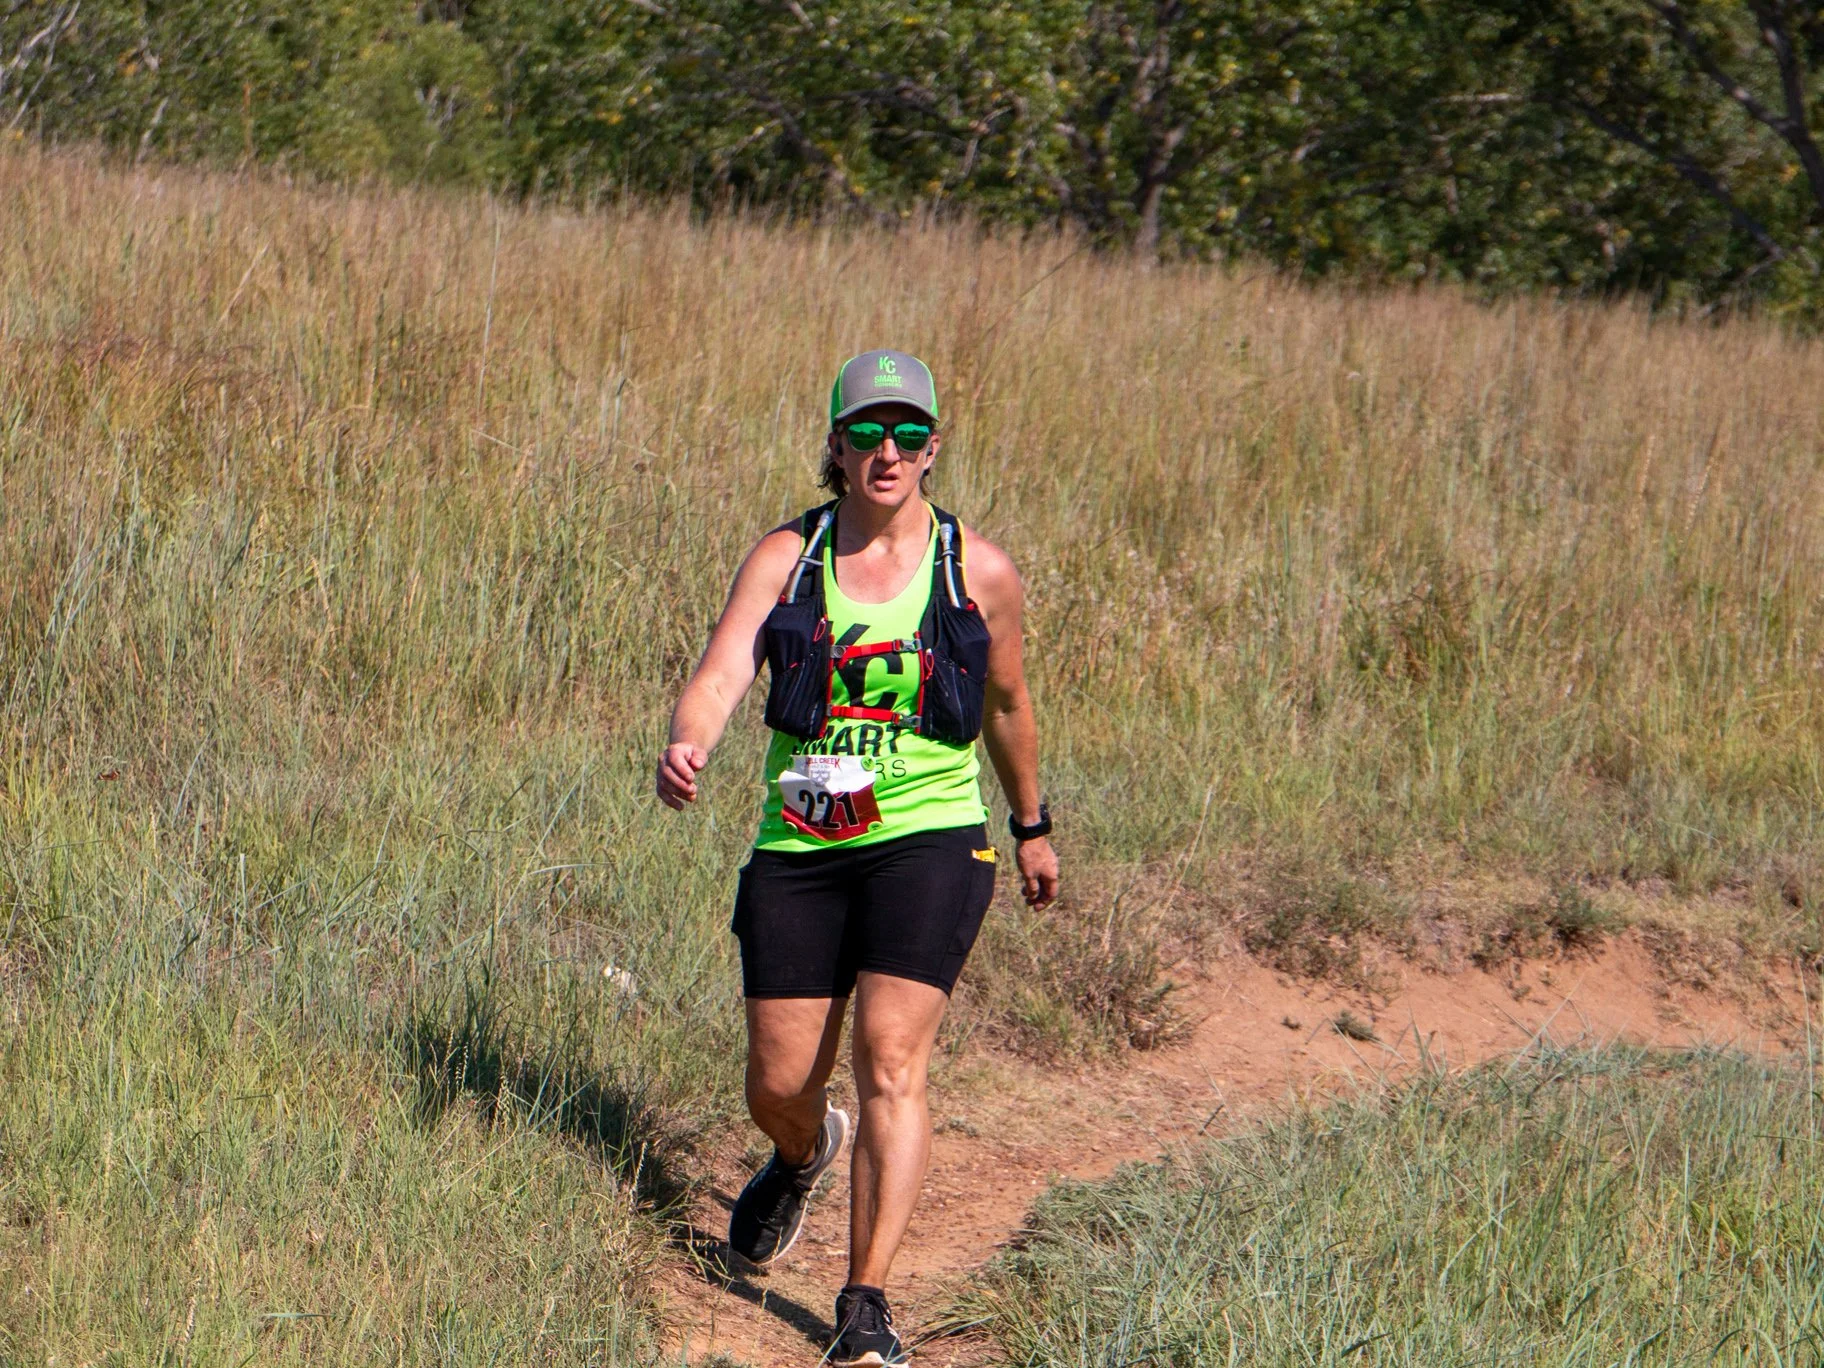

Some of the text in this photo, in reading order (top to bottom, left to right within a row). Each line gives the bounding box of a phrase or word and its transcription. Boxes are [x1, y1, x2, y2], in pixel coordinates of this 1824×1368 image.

[879, 356, 896, 374] KC
[874, 375, 903, 383] SMART
[799, 789, 860, 829] 221
